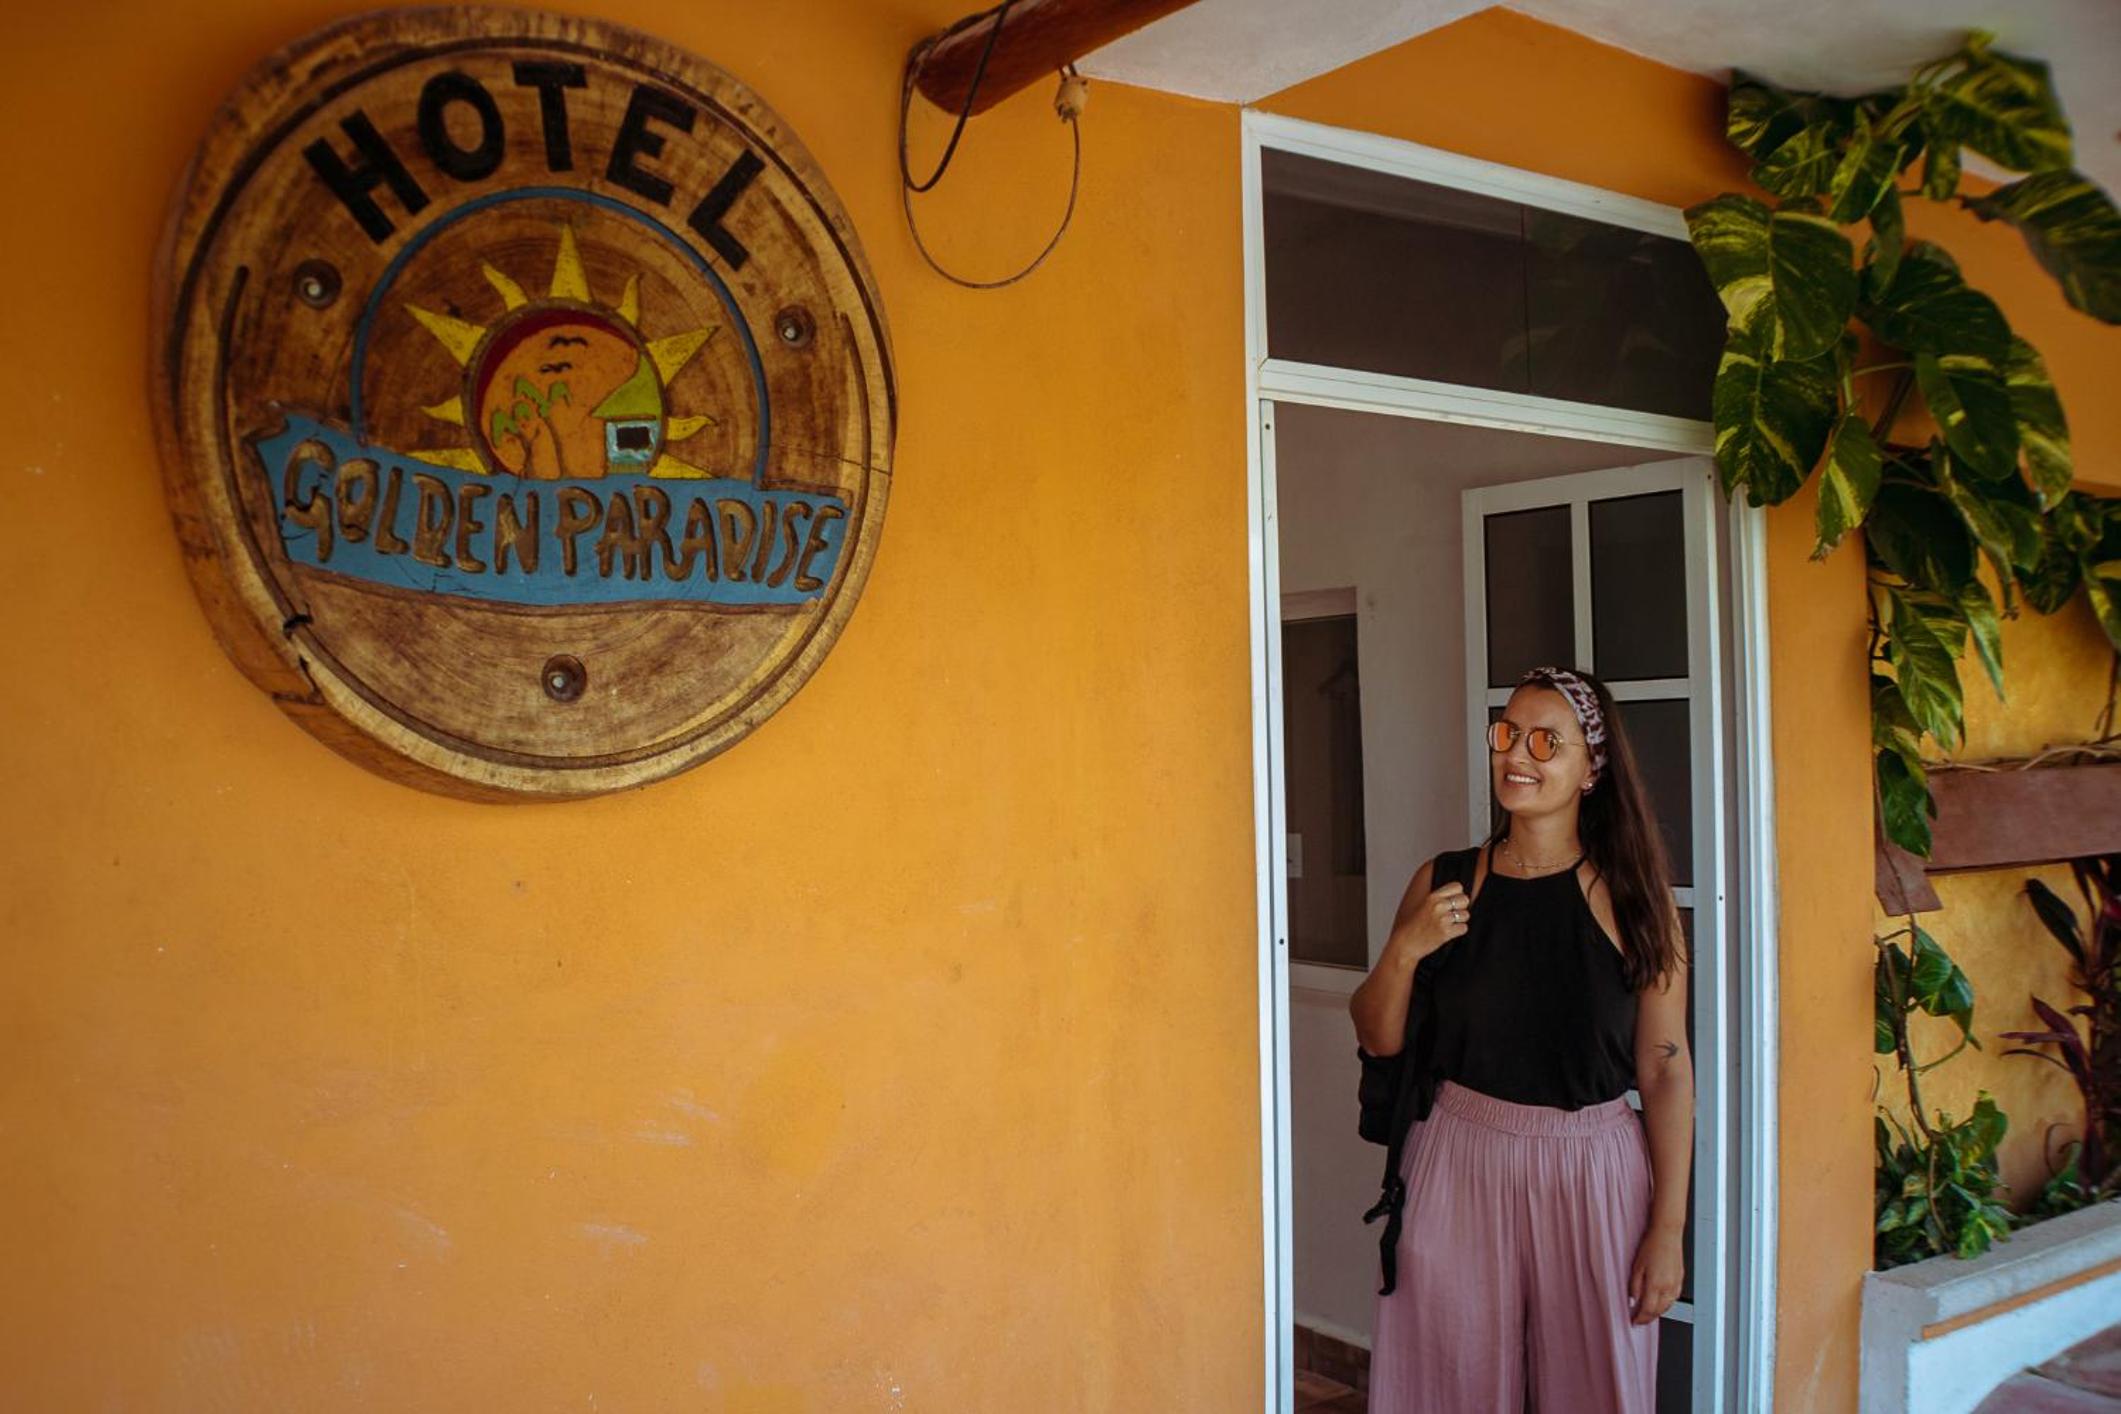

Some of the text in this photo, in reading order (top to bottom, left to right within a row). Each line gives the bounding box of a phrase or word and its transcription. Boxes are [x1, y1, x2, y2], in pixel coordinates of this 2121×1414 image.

[303, 61, 766, 271] HOTEL
[283, 439, 844, 592] GOLDEN PARADISE
